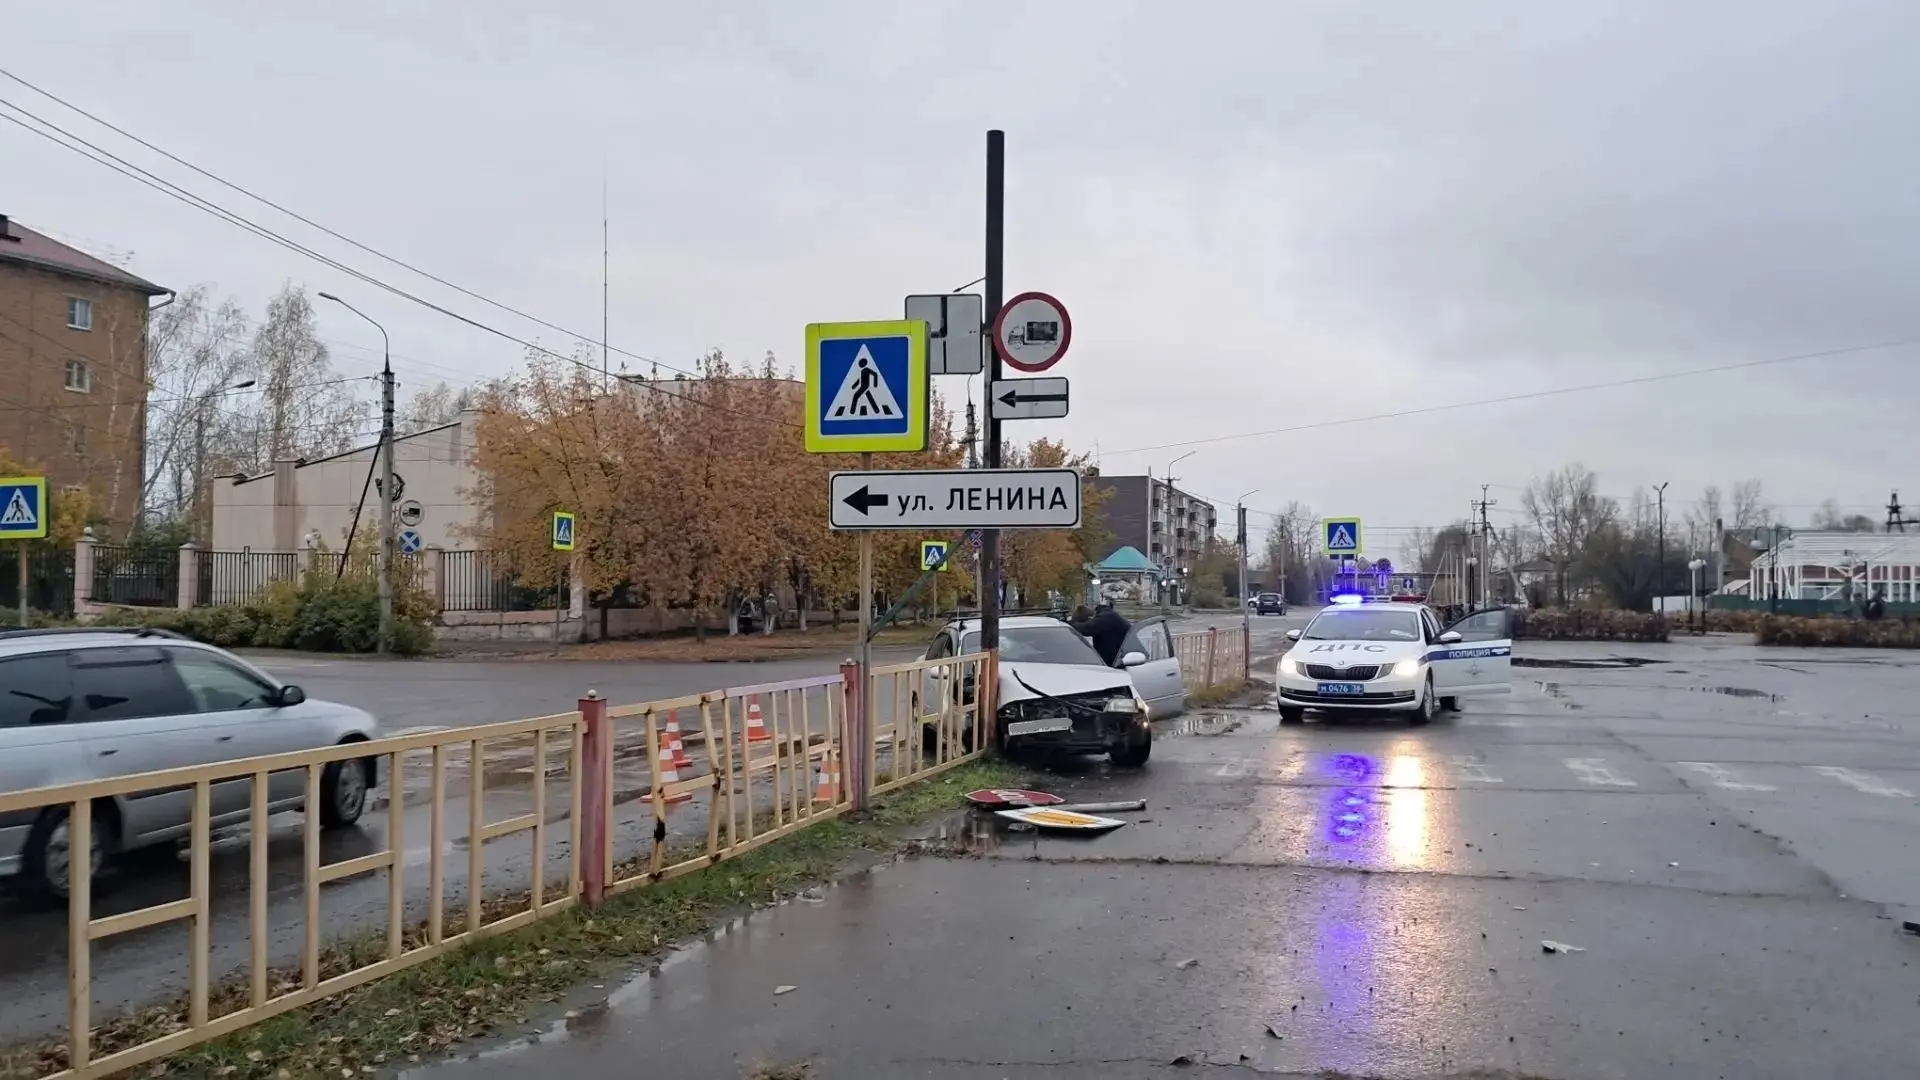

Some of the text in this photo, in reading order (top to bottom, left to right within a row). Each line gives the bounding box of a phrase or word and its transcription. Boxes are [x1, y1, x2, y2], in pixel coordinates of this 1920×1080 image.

[897, 486, 1068, 517] ул. ЛЕНИНА
[1309, 643, 1386, 653] ДПС
[1448, 648, 1491, 659] ПОЛИЦИЯ
